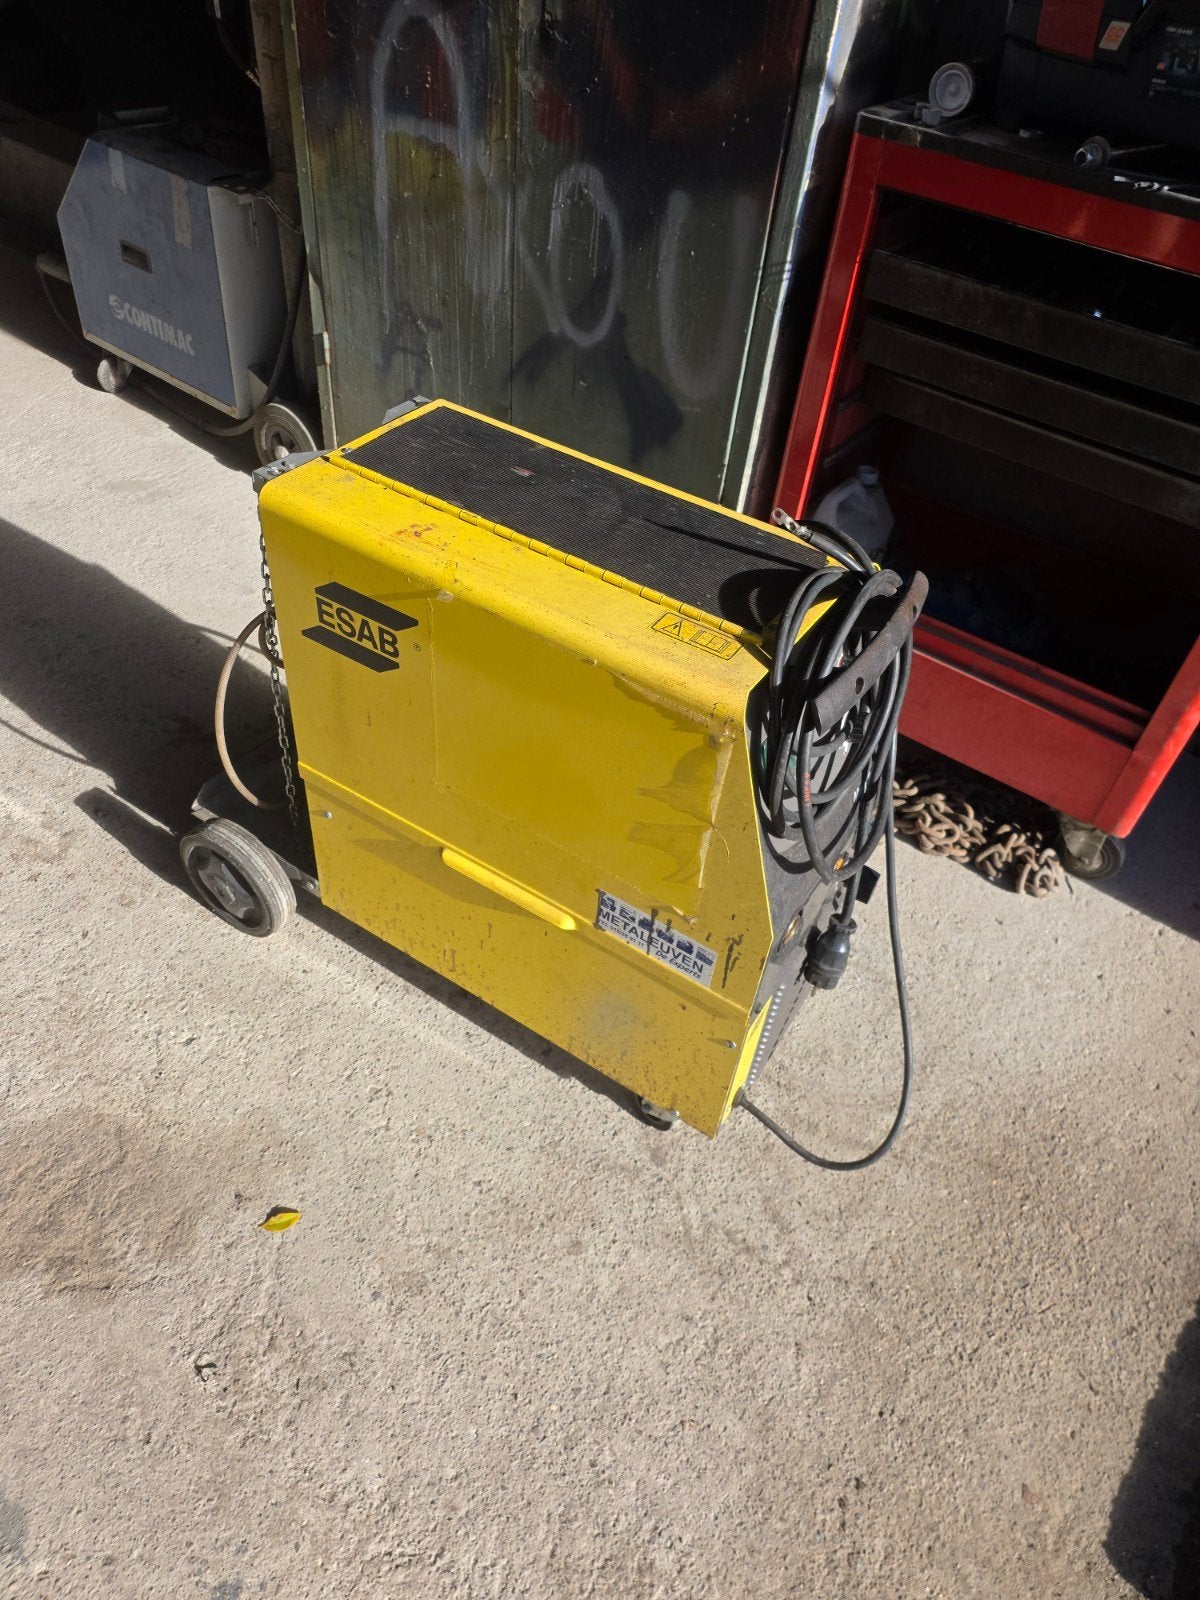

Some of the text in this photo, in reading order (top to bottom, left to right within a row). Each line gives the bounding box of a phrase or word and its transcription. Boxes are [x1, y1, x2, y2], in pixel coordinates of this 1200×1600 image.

[123, 302, 195, 356] CONTIMAC
[315, 596, 400, 659] ESAB
[598, 908, 704, 974] METALEUVEN
[656, 950, 702, 979] De Experts
